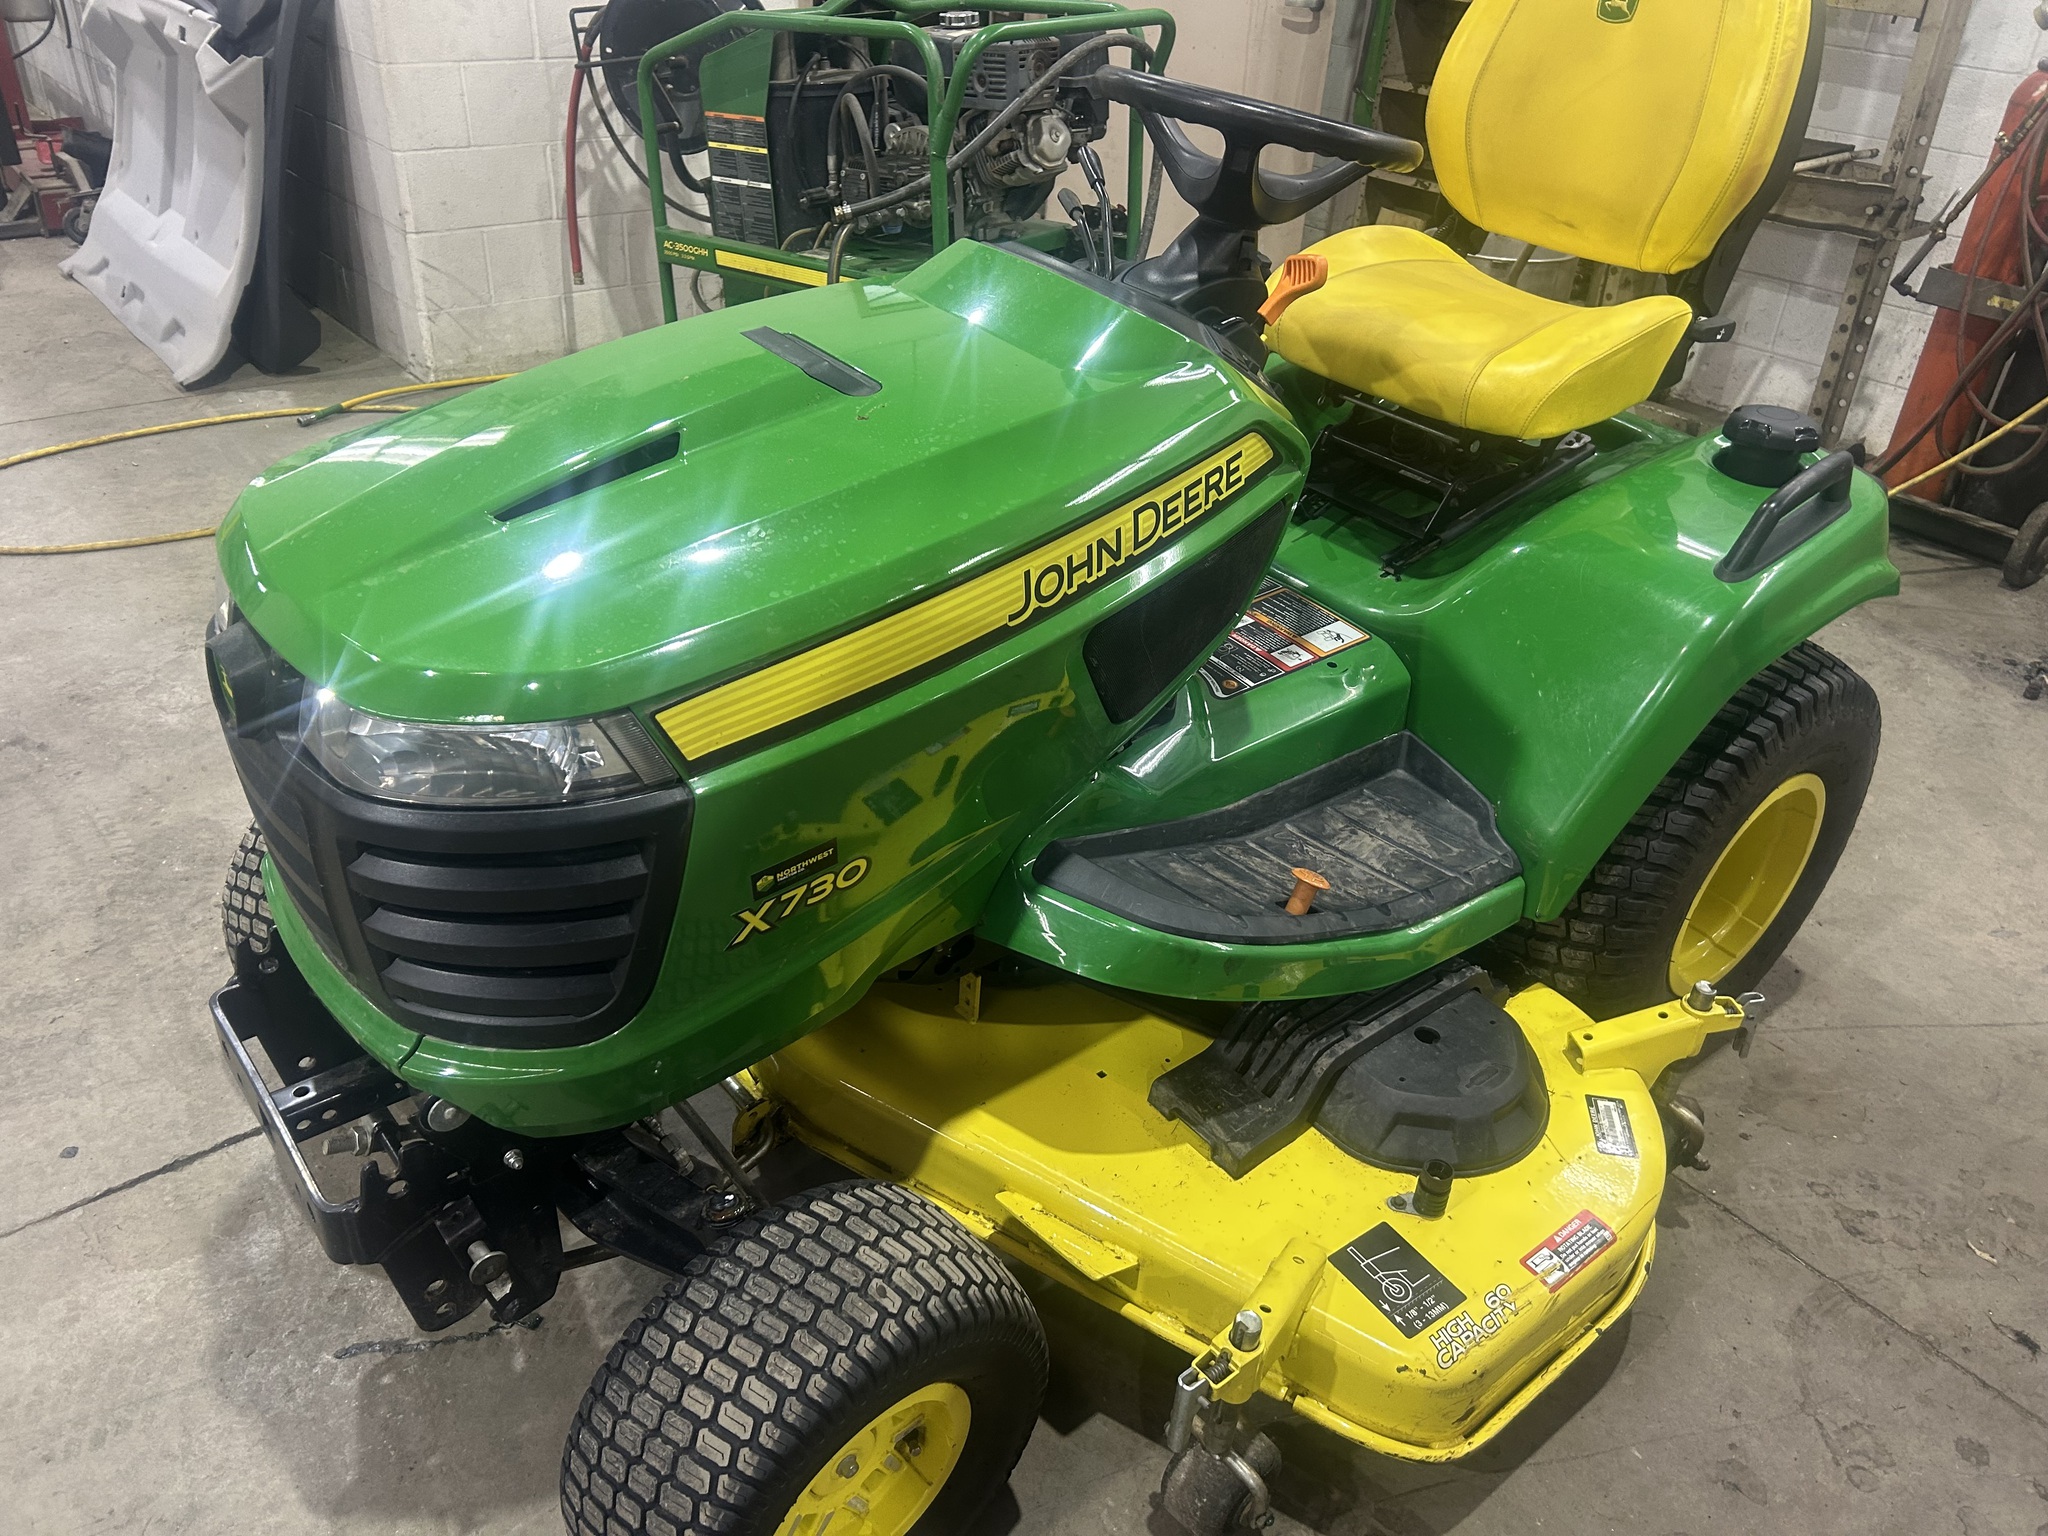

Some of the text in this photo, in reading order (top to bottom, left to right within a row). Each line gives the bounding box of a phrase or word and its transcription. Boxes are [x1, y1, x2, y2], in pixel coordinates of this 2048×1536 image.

[1007, 449, 1245, 625] JOHN DEERE
[776, 847, 834, 880] NORTHWEST
[728, 856, 870, 948] X730
[1558, 1218, 1582, 1238] DANGER
[1404, 1306, 1418, 1320] 1/8"
[1422, 1294, 1436, 1308] 1/2"
[1485, 1283, 1512, 1309] 60
[1412, 1319, 1423, 1330] (3
[1425, 1301, 1450, 1320] 13MM)
[1430, 1311, 1475, 1350] HIGH
[1437, 1301, 1518, 1369] CAPACITY
